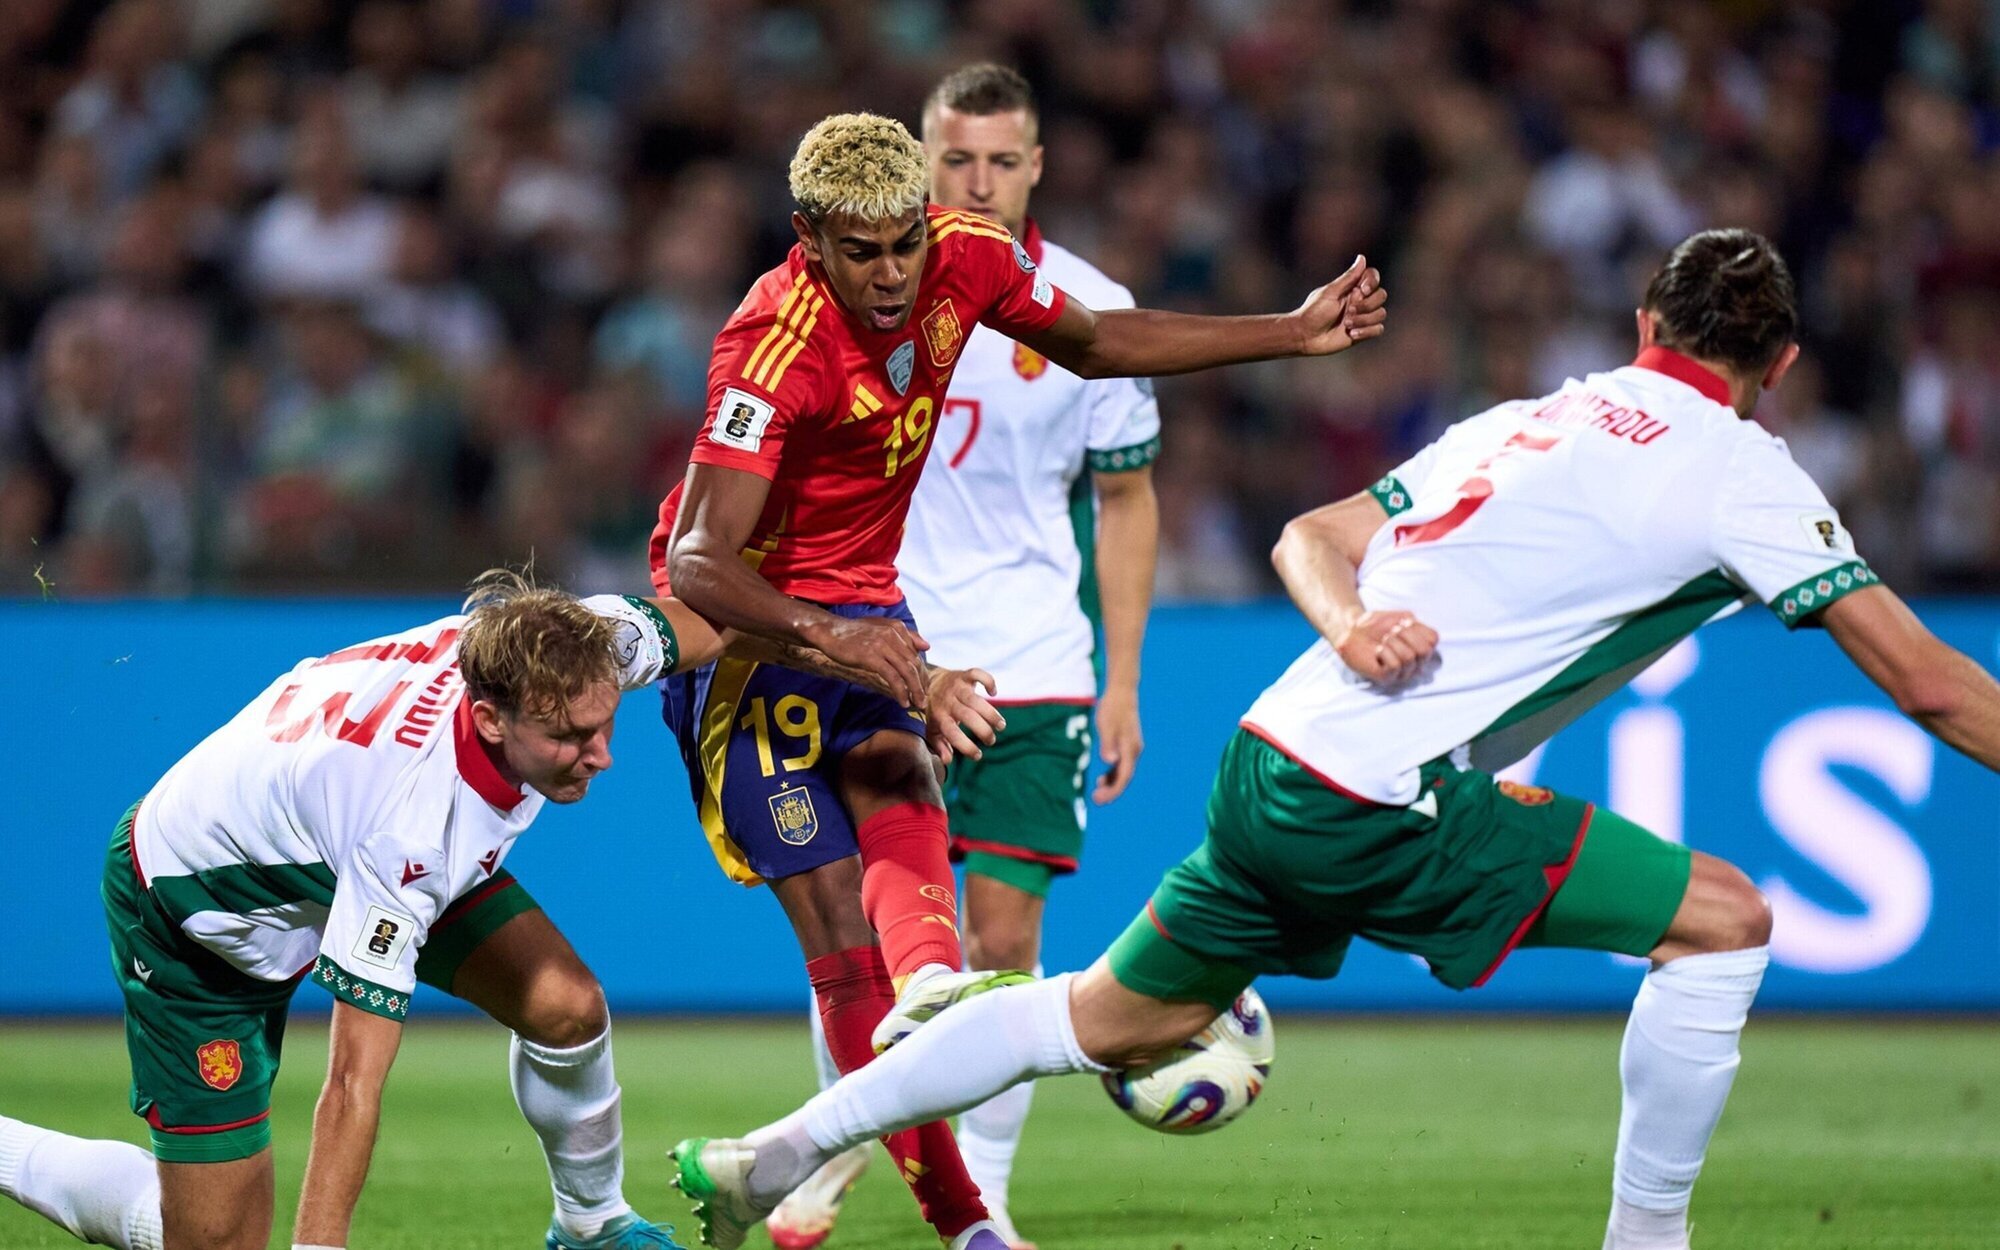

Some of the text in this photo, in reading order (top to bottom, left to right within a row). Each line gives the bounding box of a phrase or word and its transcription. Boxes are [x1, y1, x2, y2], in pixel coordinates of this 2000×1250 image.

[883, 396, 933, 478] 19
[944, 398, 982, 469] 7
[741, 694, 822, 777] 19
[1493, 632, 1934, 974] is
